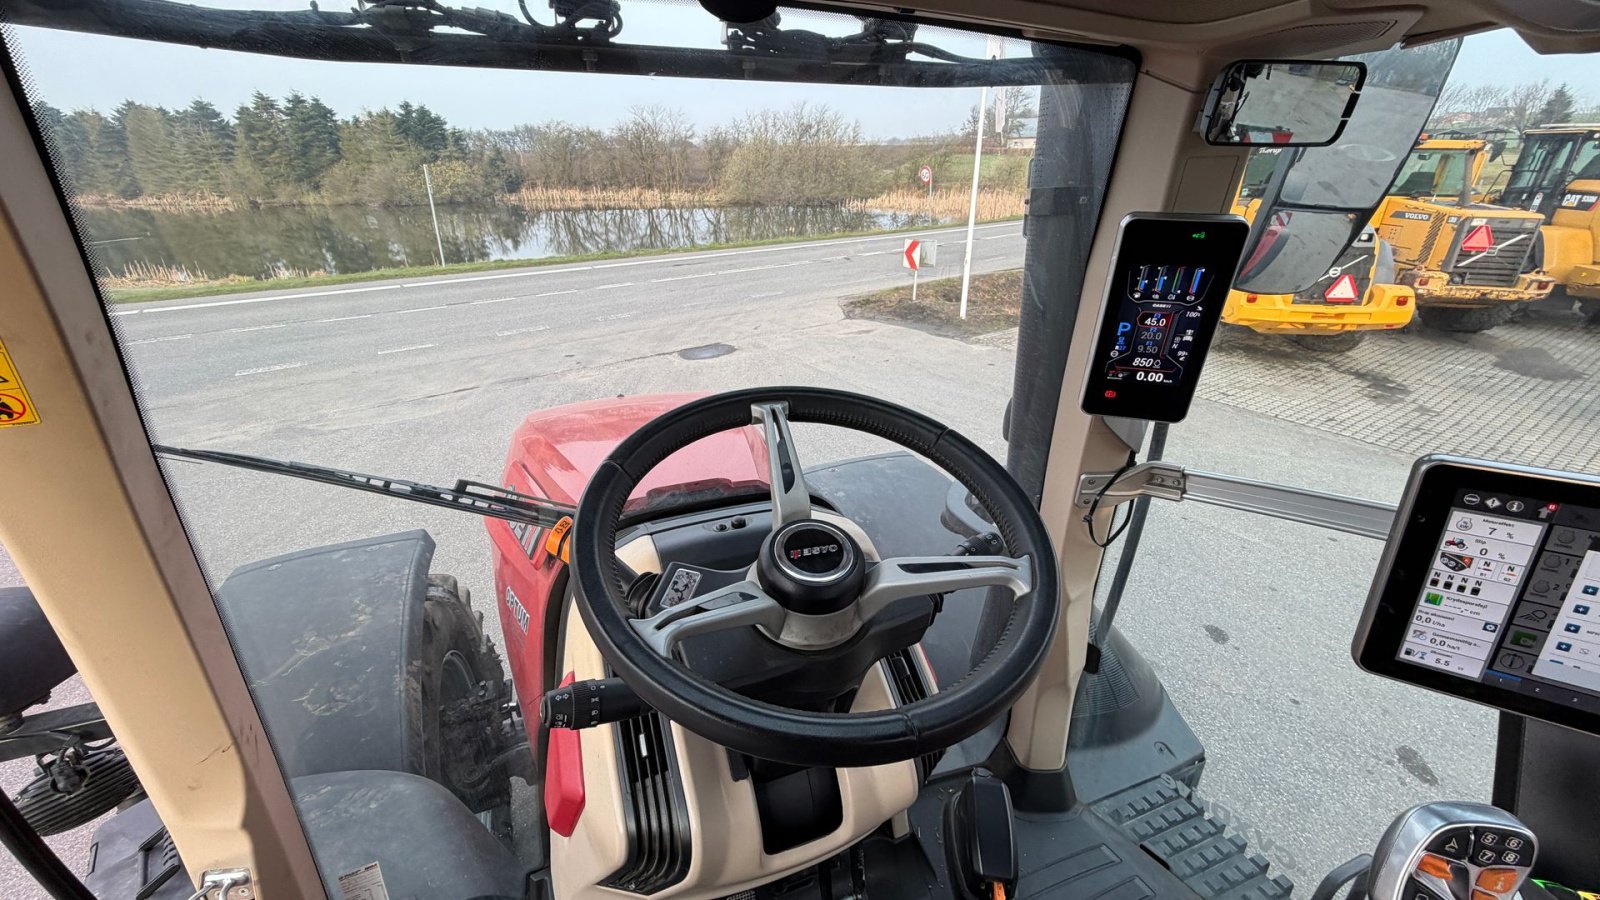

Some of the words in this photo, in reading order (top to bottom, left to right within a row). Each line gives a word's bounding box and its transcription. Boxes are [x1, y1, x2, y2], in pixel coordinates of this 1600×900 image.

[1562, 194, 1582, 207] CAT
[1405, 212, 1429, 220] VOLVO
[1144, 318, 1166, 326] 45.0
[1116, 322, 1132, 336] P
[1140, 331, 1162, 340] 20.0
[1138, 344, 1158, 354] 9.50
[1132, 357, 1153, 367] 850
[1136, 372, 1164, 382] 0.00
[1488, 526, 1497, 536] 7
[1480, 548, 1488, 556] 0
[506, 586, 530, 636] OPTUM
[1416, 614, 1432, 624] 0,0
[1430, 637, 1446, 647] 0,0
[1434, 658, 1450, 667] 5.5
